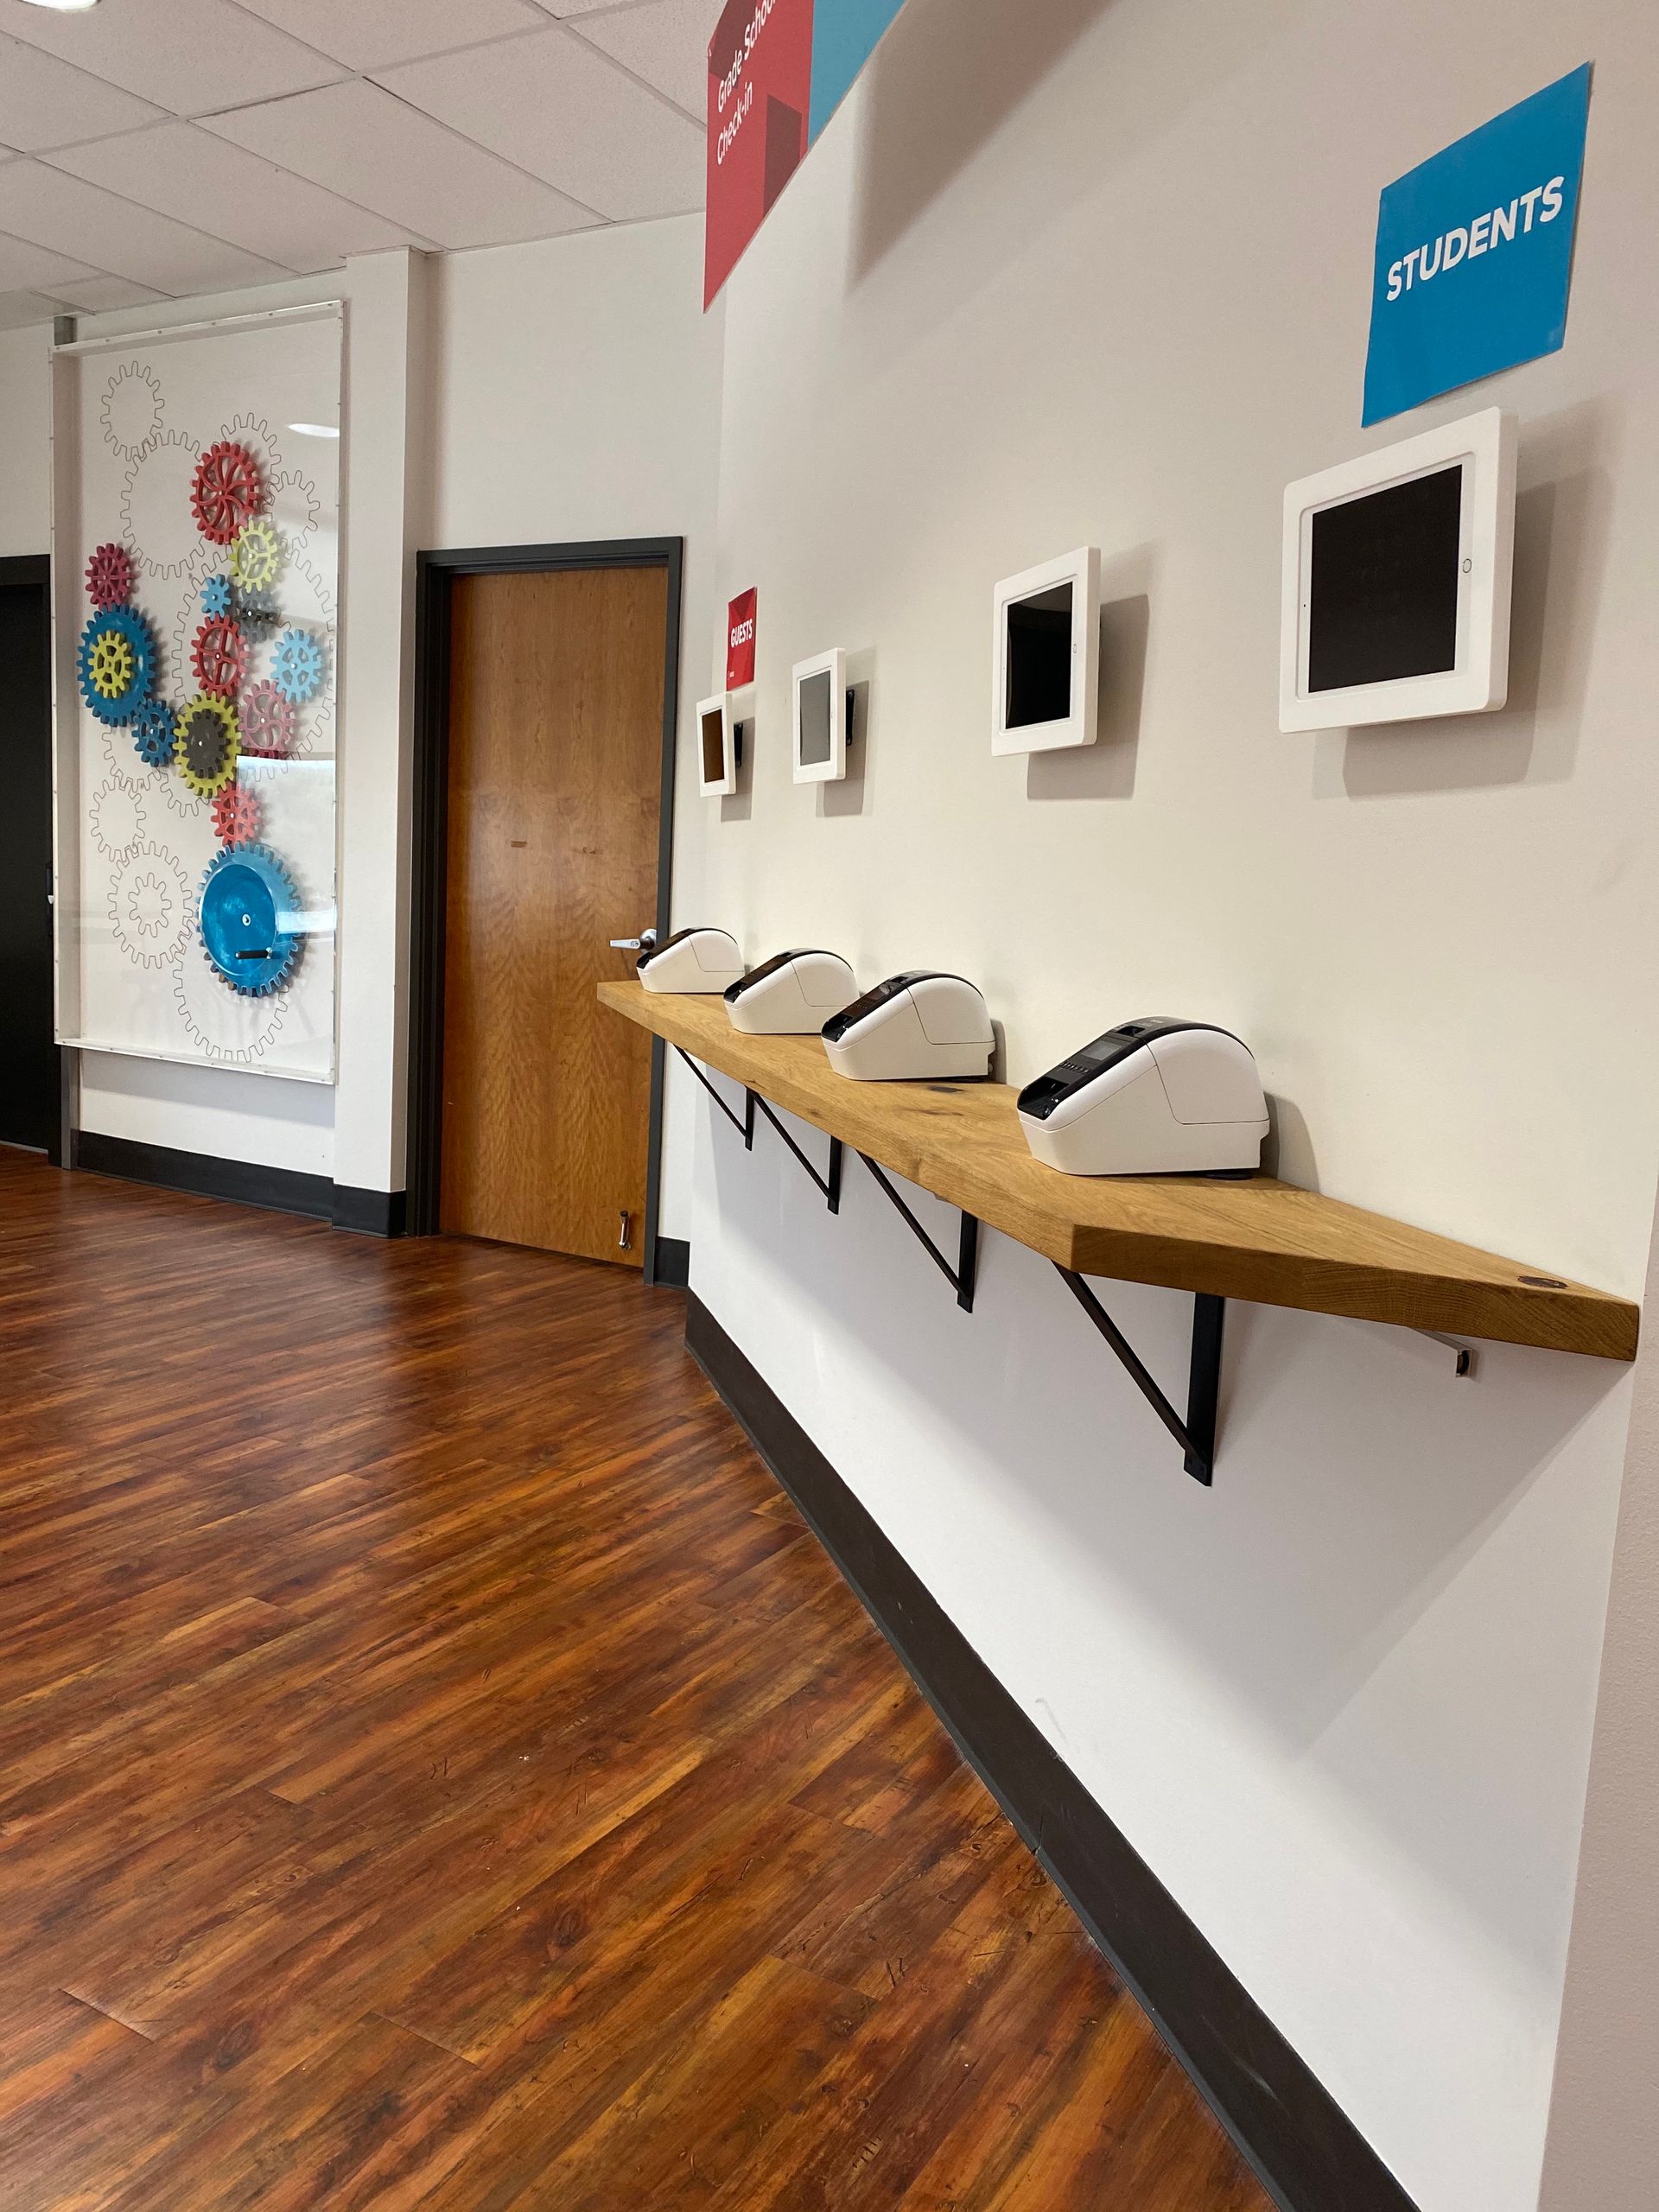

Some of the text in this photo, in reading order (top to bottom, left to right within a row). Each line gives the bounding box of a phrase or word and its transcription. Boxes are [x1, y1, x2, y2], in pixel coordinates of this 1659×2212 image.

[718, 49, 742, 113] Grade
[717, 80, 753, 165] Check-in
[1387, 176, 1565, 302] STUDENTS
[730, 618, 753, 648] GUESTS
